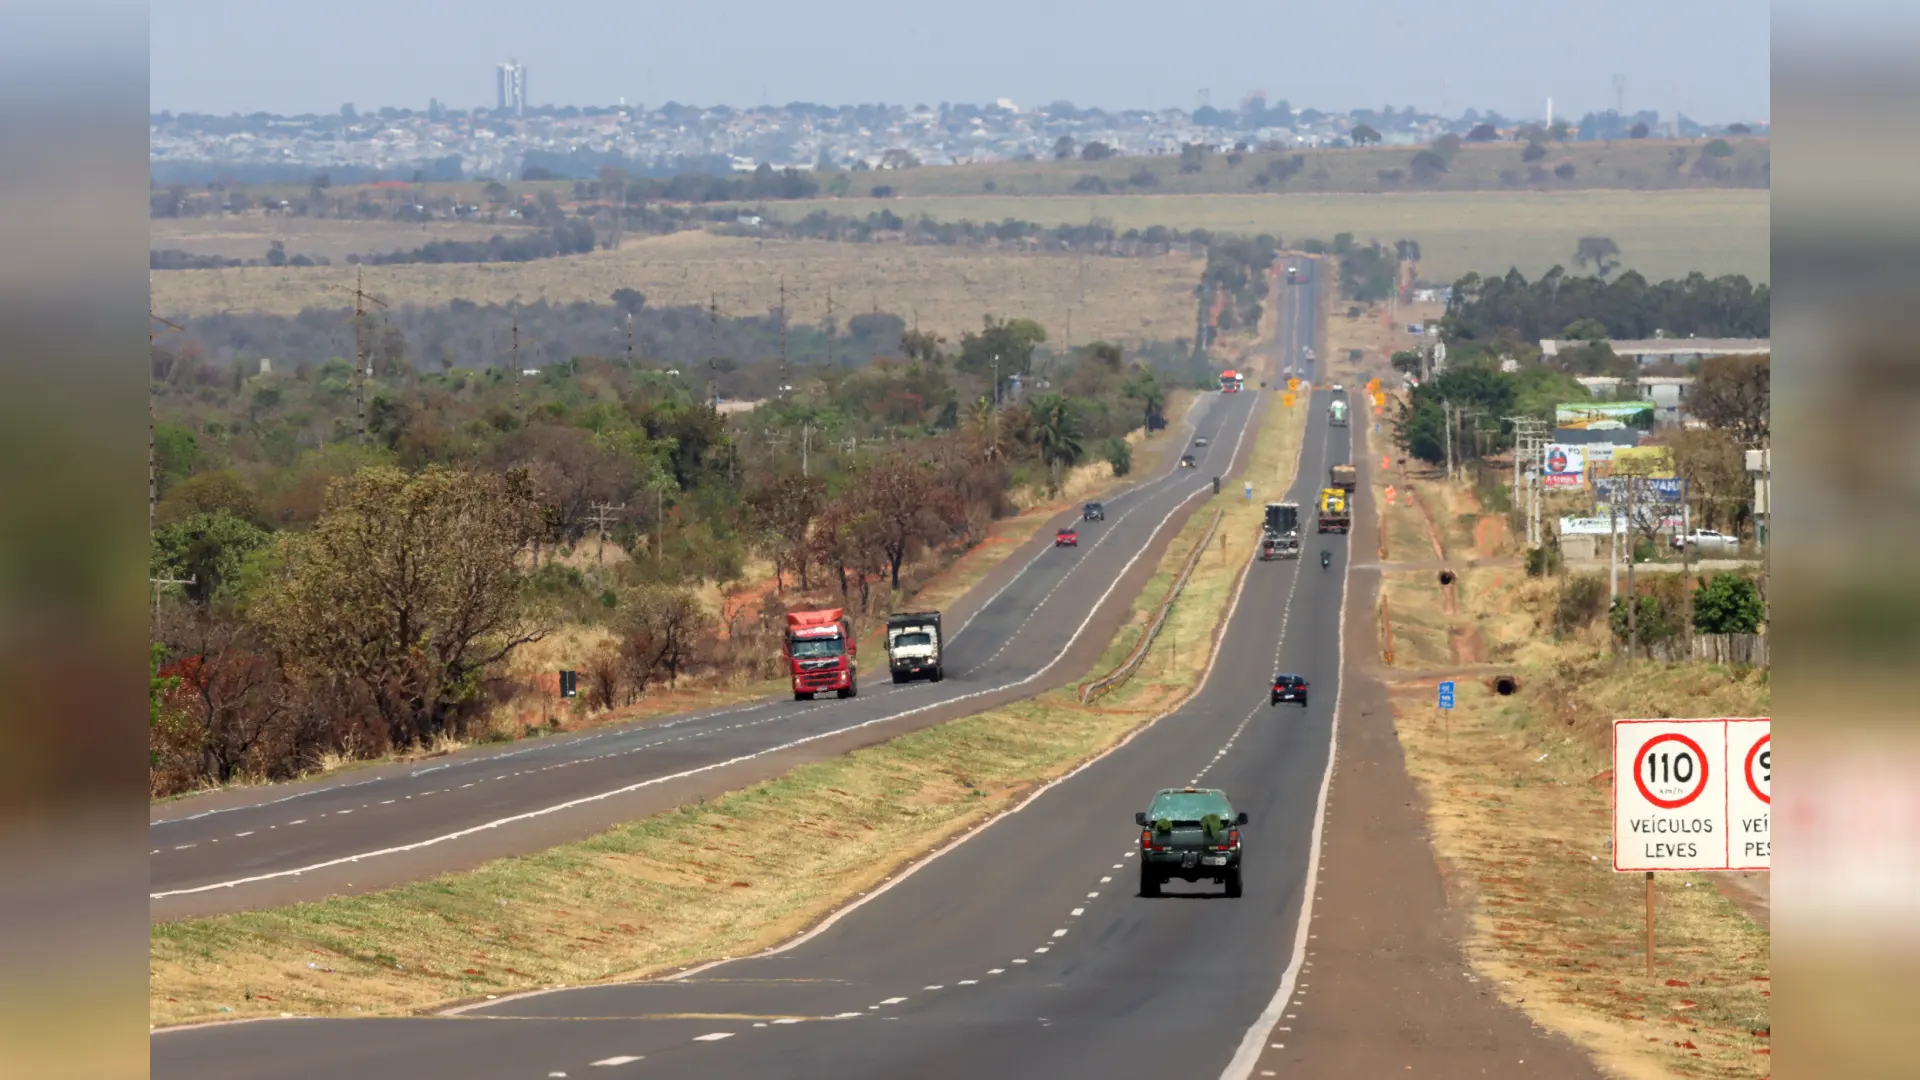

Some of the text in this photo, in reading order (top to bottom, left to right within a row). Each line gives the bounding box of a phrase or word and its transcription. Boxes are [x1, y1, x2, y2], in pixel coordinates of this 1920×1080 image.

[1648, 752, 1694, 783] 110
[1630, 814, 1713, 833] VEÍCULOS
[1645, 843, 1698, 858] LEVES
